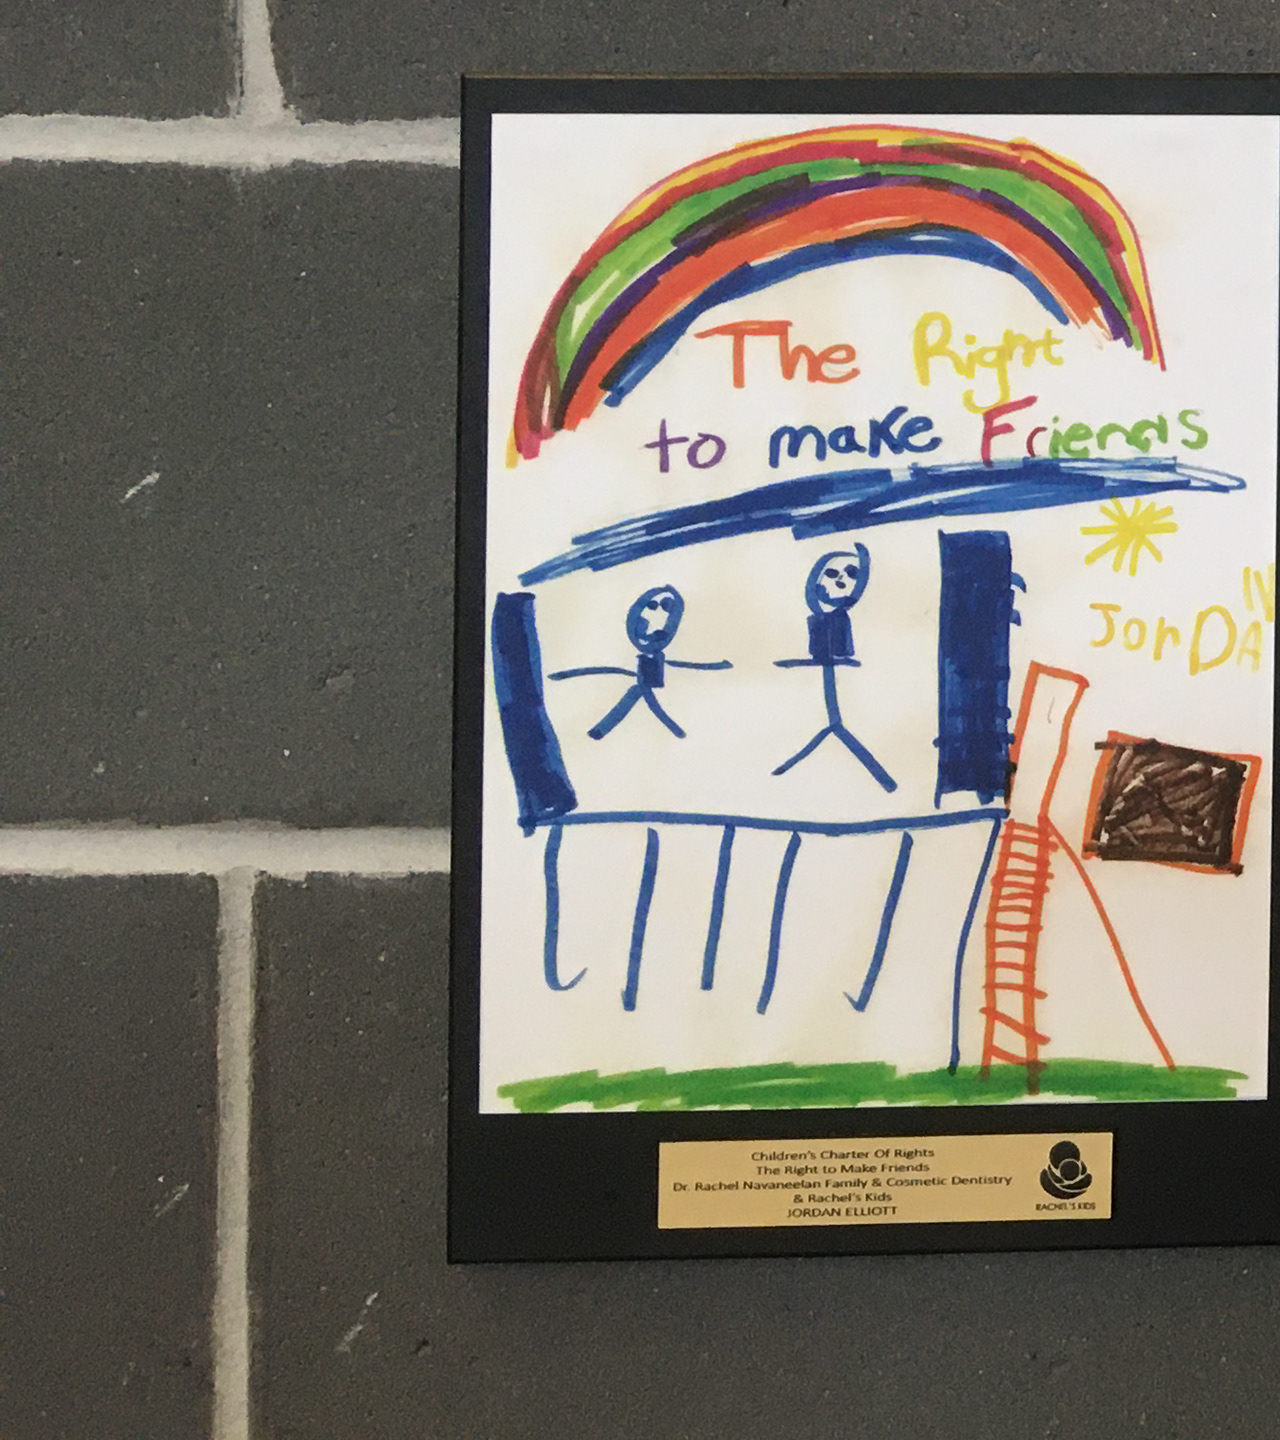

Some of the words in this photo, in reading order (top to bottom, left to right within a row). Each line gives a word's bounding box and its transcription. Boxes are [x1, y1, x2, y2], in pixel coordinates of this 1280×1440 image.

[692, 320, 861, 389] The
[913, 312, 1064, 415] Right
[644, 418, 727, 473] to
[979, 395, 1209, 468] Friends
[751, 1150, 816, 1161] Children's
[820, 1149, 870, 1160] Charter
[874, 1148, 890, 1158] Of
[894, 1148, 935, 1160] Rights
[756, 1165, 781, 1176] The
[784, 1164, 818, 1177] Right
[823, 1165, 837, 1174] to
[840, 1163, 877, 1174] Make
[881, 1162, 930, 1173] Friends
[673, 1182, 690, 1192] Dr.
[694, 1181, 739, 1192] Rachel
[825, 1177, 868, 1190] Family
[871, 1178, 882, 1188] &
[886, 1176, 947, 1188] Cosmetic
[951, 1175, 1013, 1187] Dentistry
[793, 1193, 804, 1204] &
[807, 1192, 862, 1204] Rachel's
[865, 1192, 893, 1202] Kids
[787, 1207, 841, 1218] JORDAN
[845, 1206, 898, 1217] ELLIOTT
